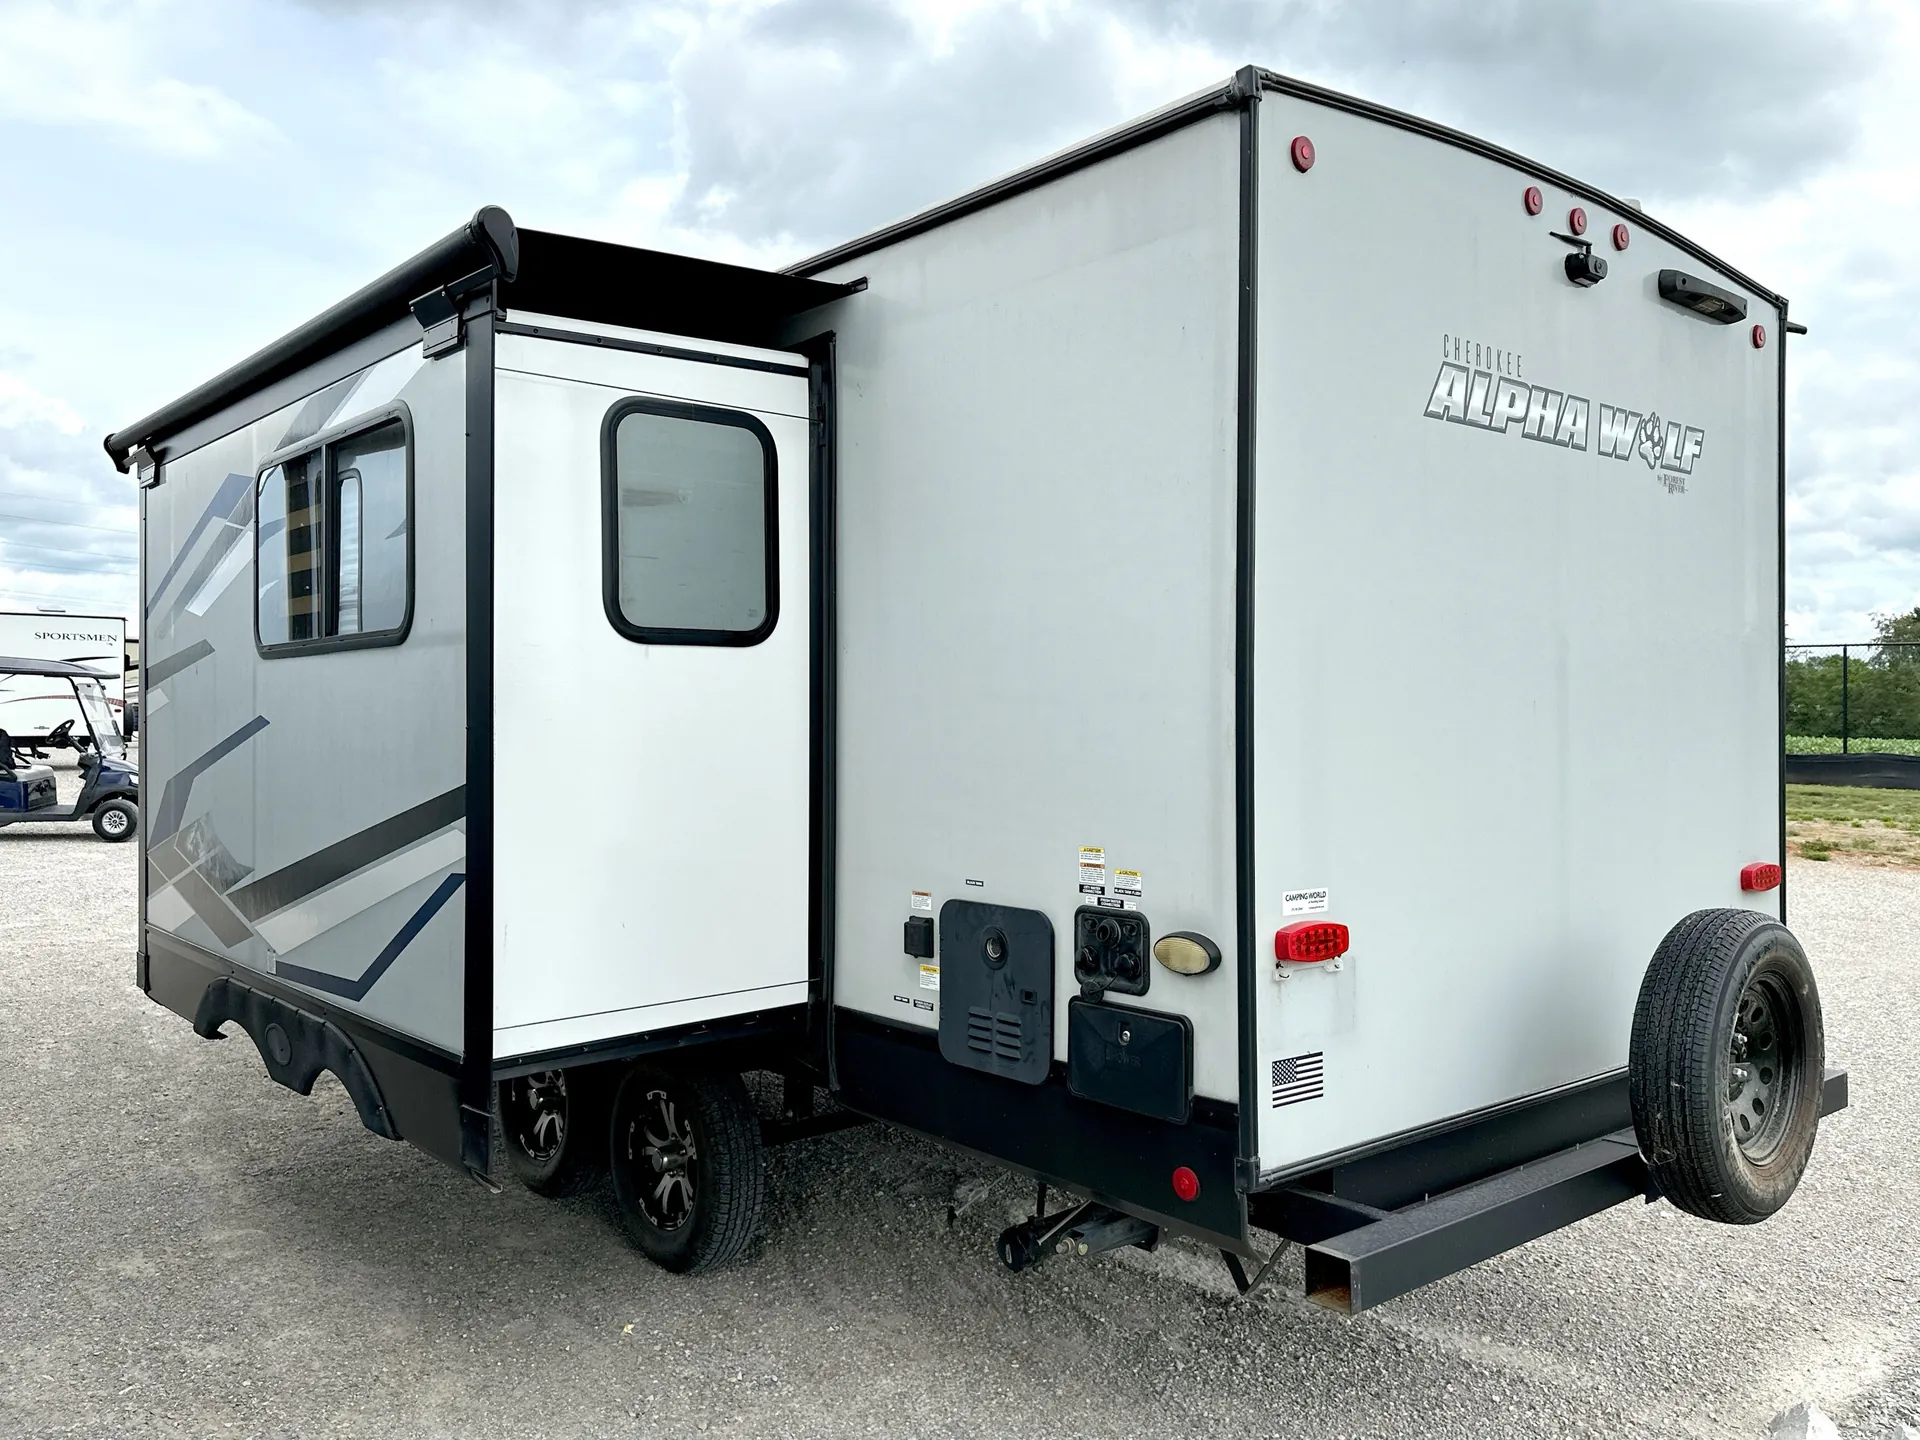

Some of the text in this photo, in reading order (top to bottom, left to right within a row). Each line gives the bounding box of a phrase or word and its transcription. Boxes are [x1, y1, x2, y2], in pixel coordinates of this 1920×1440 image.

[1443, 333, 1522, 378] CHEROKEE
[1423, 360, 1590, 452] ALPHA
[34, 631, 118, 642] SPORTSMEN
[1285, 893, 1308, 902] CAMPING
[1308, 891, 1327, 899] WORLD
